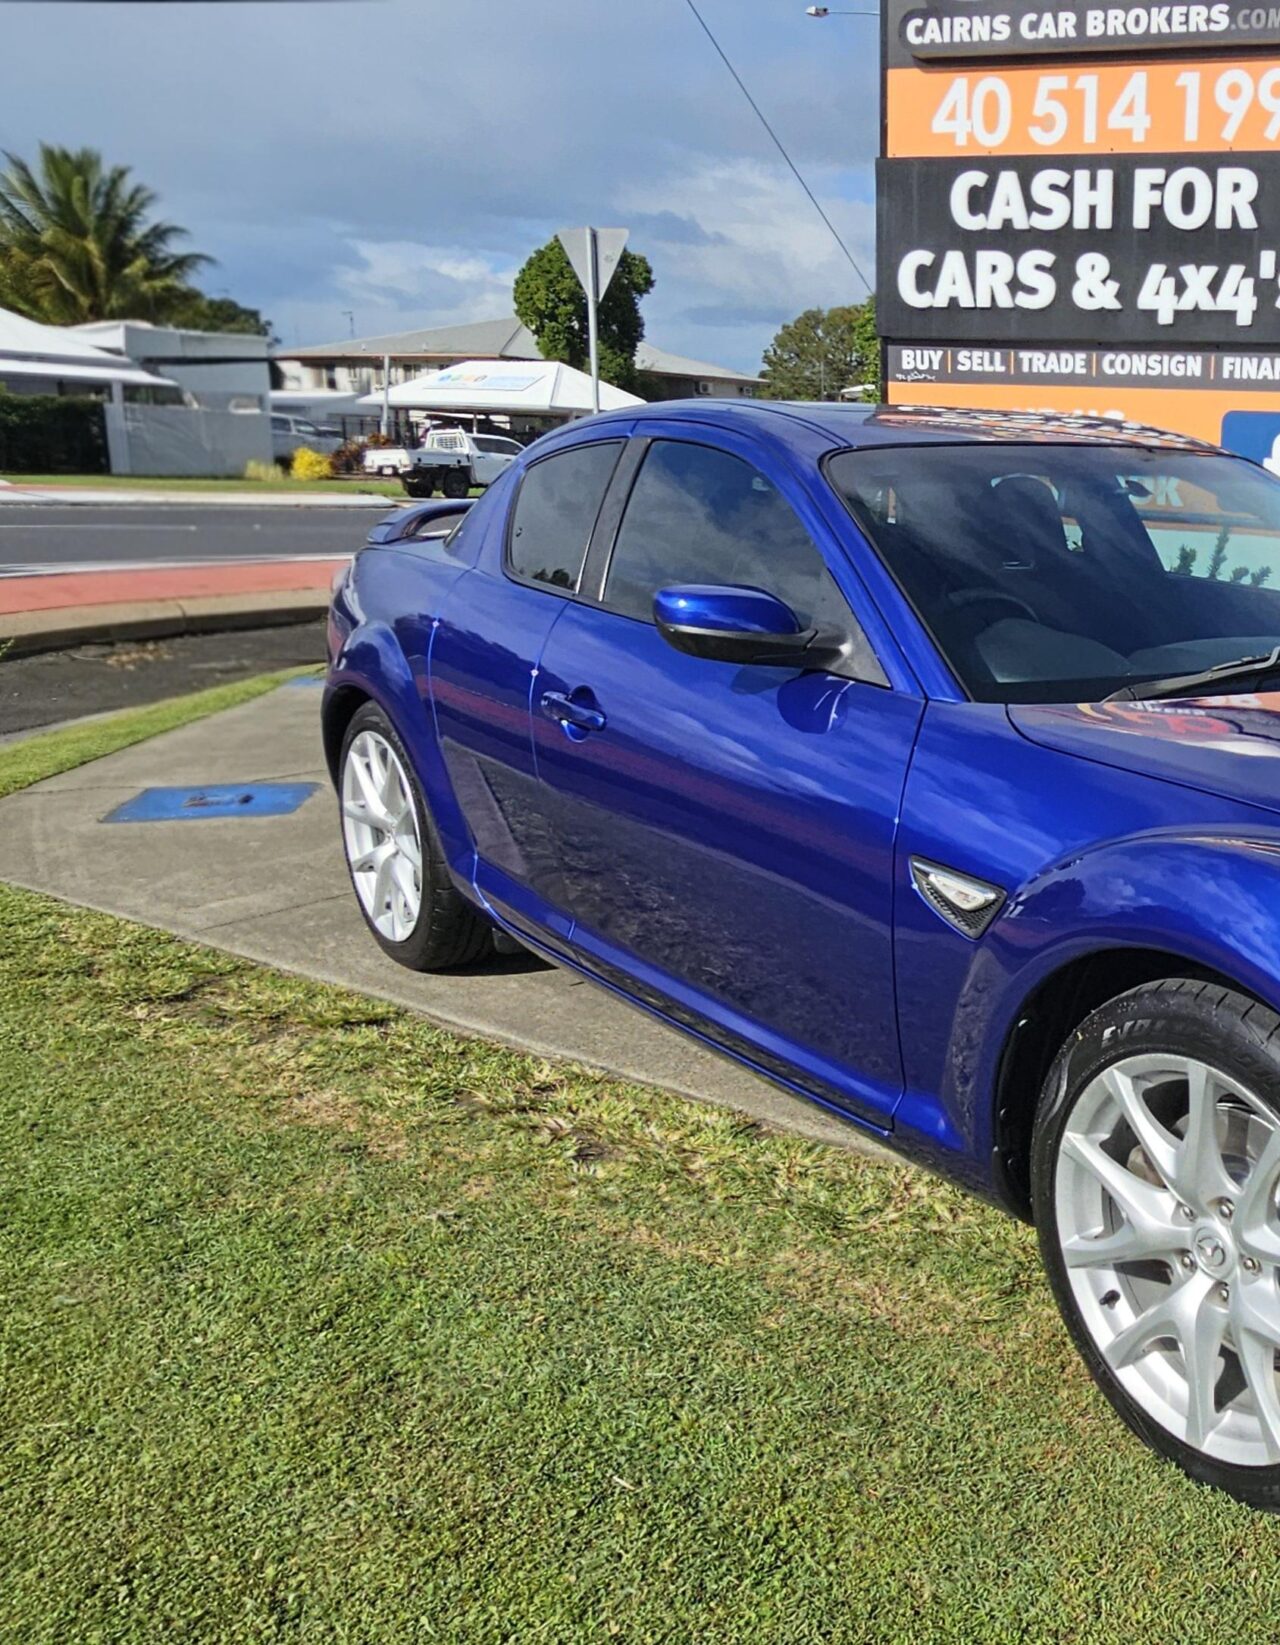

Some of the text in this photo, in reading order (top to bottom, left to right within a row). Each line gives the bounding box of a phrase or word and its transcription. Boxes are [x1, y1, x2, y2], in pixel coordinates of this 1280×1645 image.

[906, 14, 1011, 45] CAIRNS
[1019, 12, 1077, 40] CAR
[931, 76, 1012, 147] 40
[1028, 71, 1152, 146] 514
[950, 166, 1259, 231] CASH FOR
[898, 249, 1057, 309] CARS
[1072, 252, 1123, 310] &
[902, 350, 944, 370] BUY
[956, 350, 1005, 372] SELL
[1019, 352, 1087, 374] TRADE
[1102, 353, 1202, 377] CONSIGN
